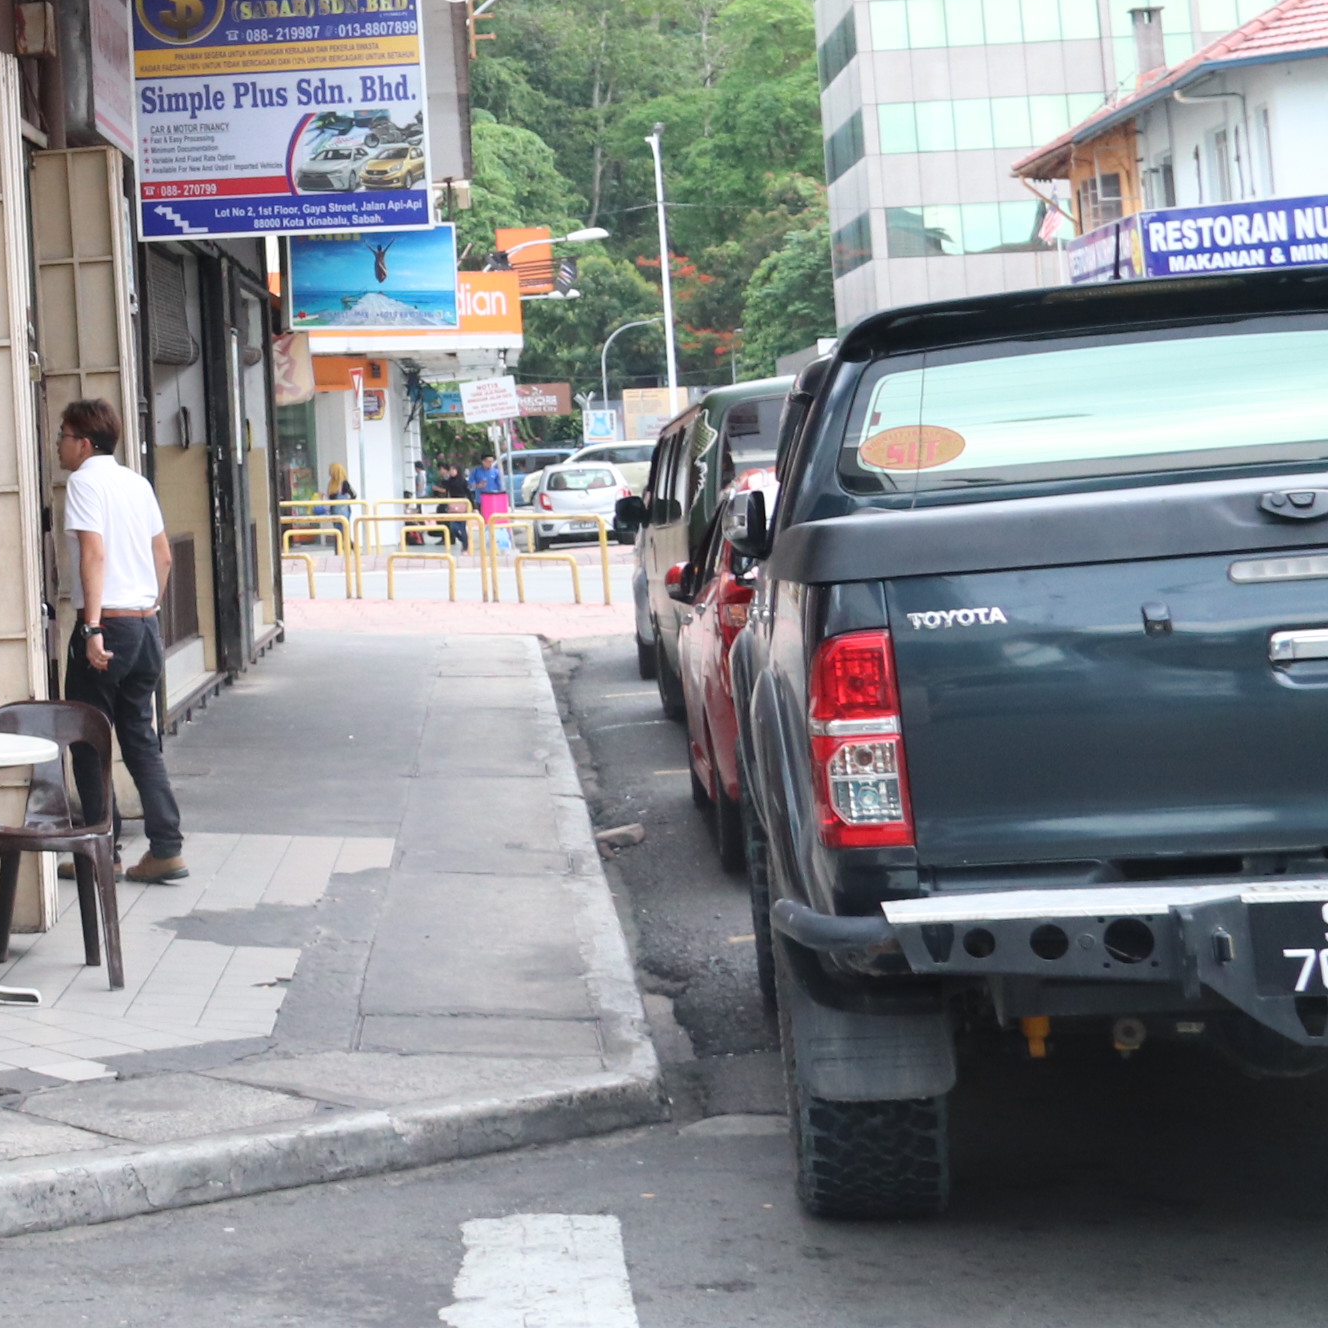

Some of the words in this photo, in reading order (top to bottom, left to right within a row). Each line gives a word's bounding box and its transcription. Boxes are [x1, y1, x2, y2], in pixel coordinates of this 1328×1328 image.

[276, 25, 320, 41] 219987
[141, 83, 225, 119] Simple
[233, 80, 288, 110] Plus
[297, 77, 352, 106] Sdn.
[359, 73, 417, 102] Bhd.
[174, 124, 198, 134] MOTOR
[199, 122, 230, 132] FINANCY
[183, 183, 217, 196] 270799
[215, 207, 231, 217] Lot
[232, 207, 246, 217] No
[258, 206, 272, 216] 1st
[303, 204, 327, 216] Gaya
[361, 201, 385, 212] Jalan
[387, 199, 423, 212] Api-Api
[283, 217, 304, 227] Kota
[1148, 209, 1289, 253] RESTORAN
[1169, 247, 1265, 272] MAKANAN
[907, 606, 1008, 630] TOYOTA
